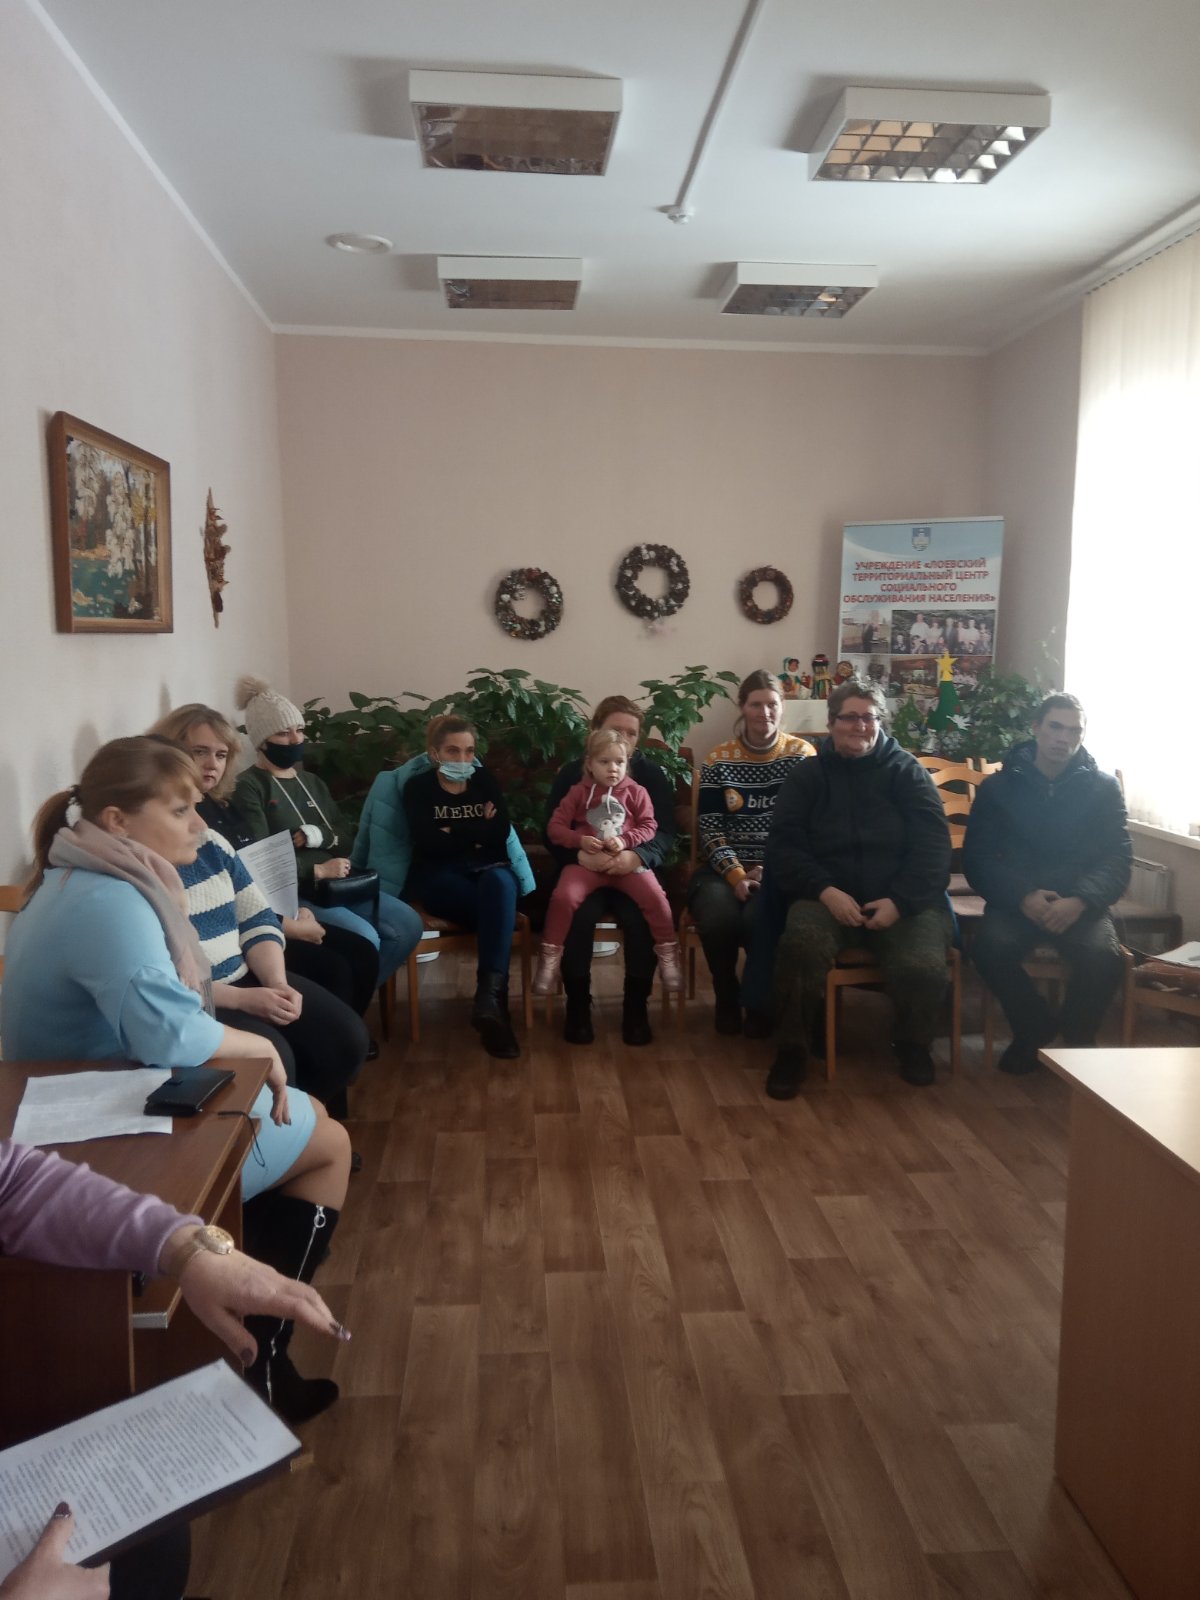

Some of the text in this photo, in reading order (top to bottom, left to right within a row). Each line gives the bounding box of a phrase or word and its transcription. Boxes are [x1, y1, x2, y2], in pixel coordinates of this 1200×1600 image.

[855, 557, 986, 571] УЧРЕЖДЕНИЕ «ЛОЕВСКИЙ
[852, 569, 989, 582] ТЕРРИТОРИАЛЬНЫЙ ЦЕНТР
[880, 582, 957, 593] СОЦИАЛЬНОГО
[843, 593, 996, 603] ОБСЛУЖИВАНИЯ НАСЕЛЕНИЯ»
